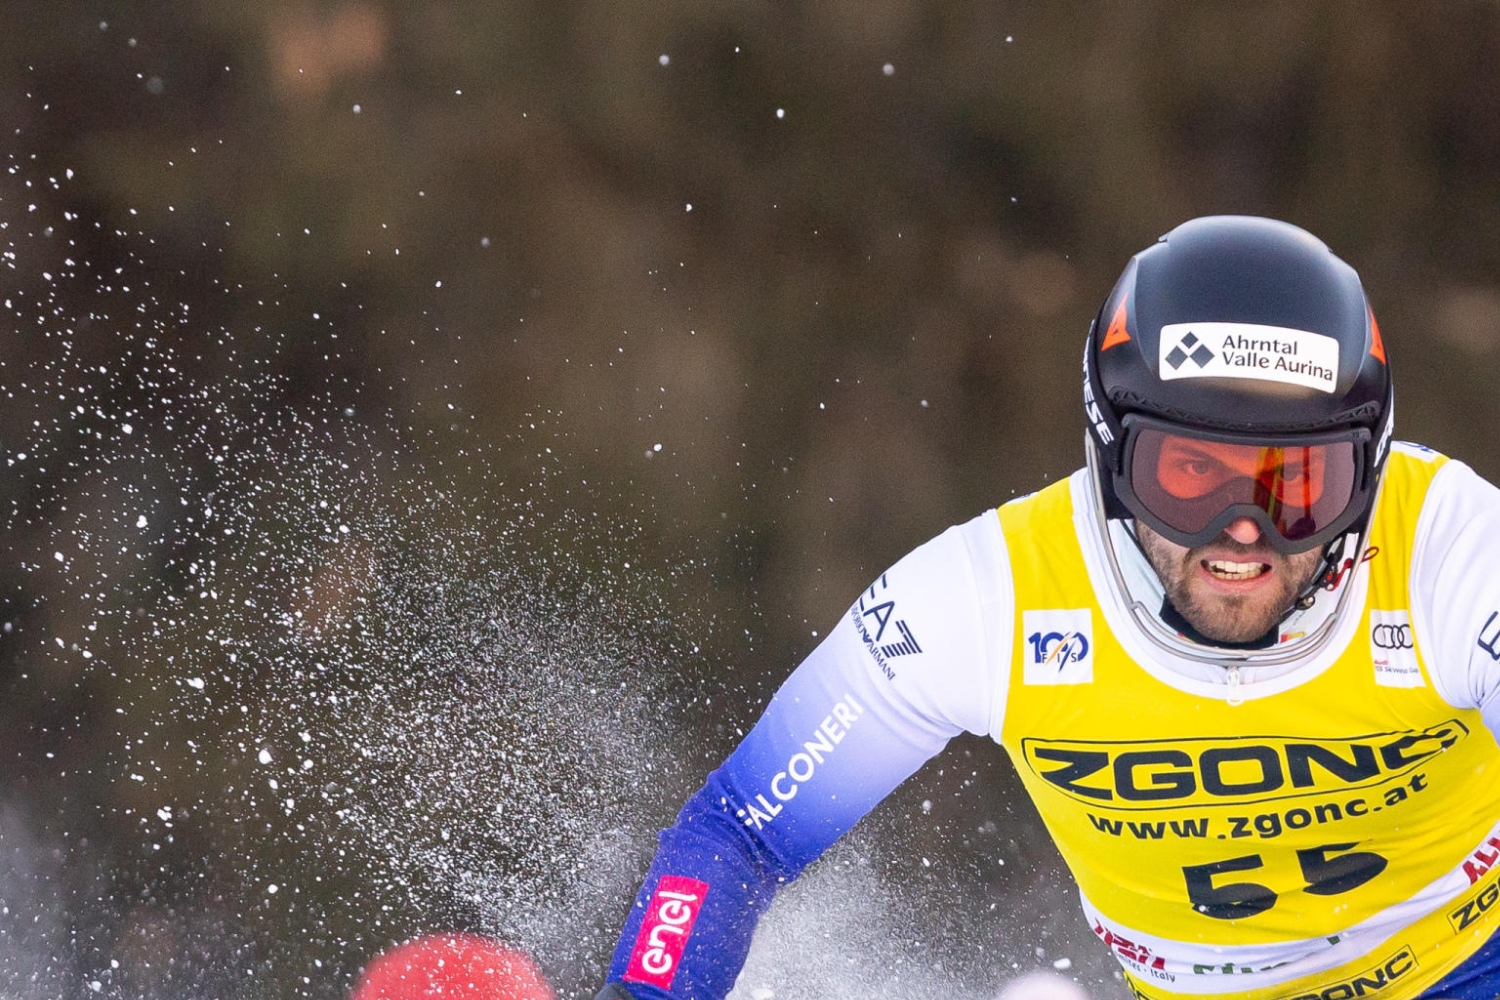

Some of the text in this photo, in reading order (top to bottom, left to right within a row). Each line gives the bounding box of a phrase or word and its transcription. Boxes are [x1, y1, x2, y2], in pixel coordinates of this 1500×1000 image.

[1222, 335, 1298, 355] Ahrntal
[1222, 351, 1333, 381] Valle Aurina
[867, 643, 896, 681] ARMANI
[737, 693, 864, 831] ALCONERI
[1034, 728, 1459, 801] ZGONC
[1087, 771, 1429, 840] www.zgonc.at
[1182, 840, 1389, 920] 55
[642, 891, 698, 975] enel
[1150, 969, 1176, 983] Italy
